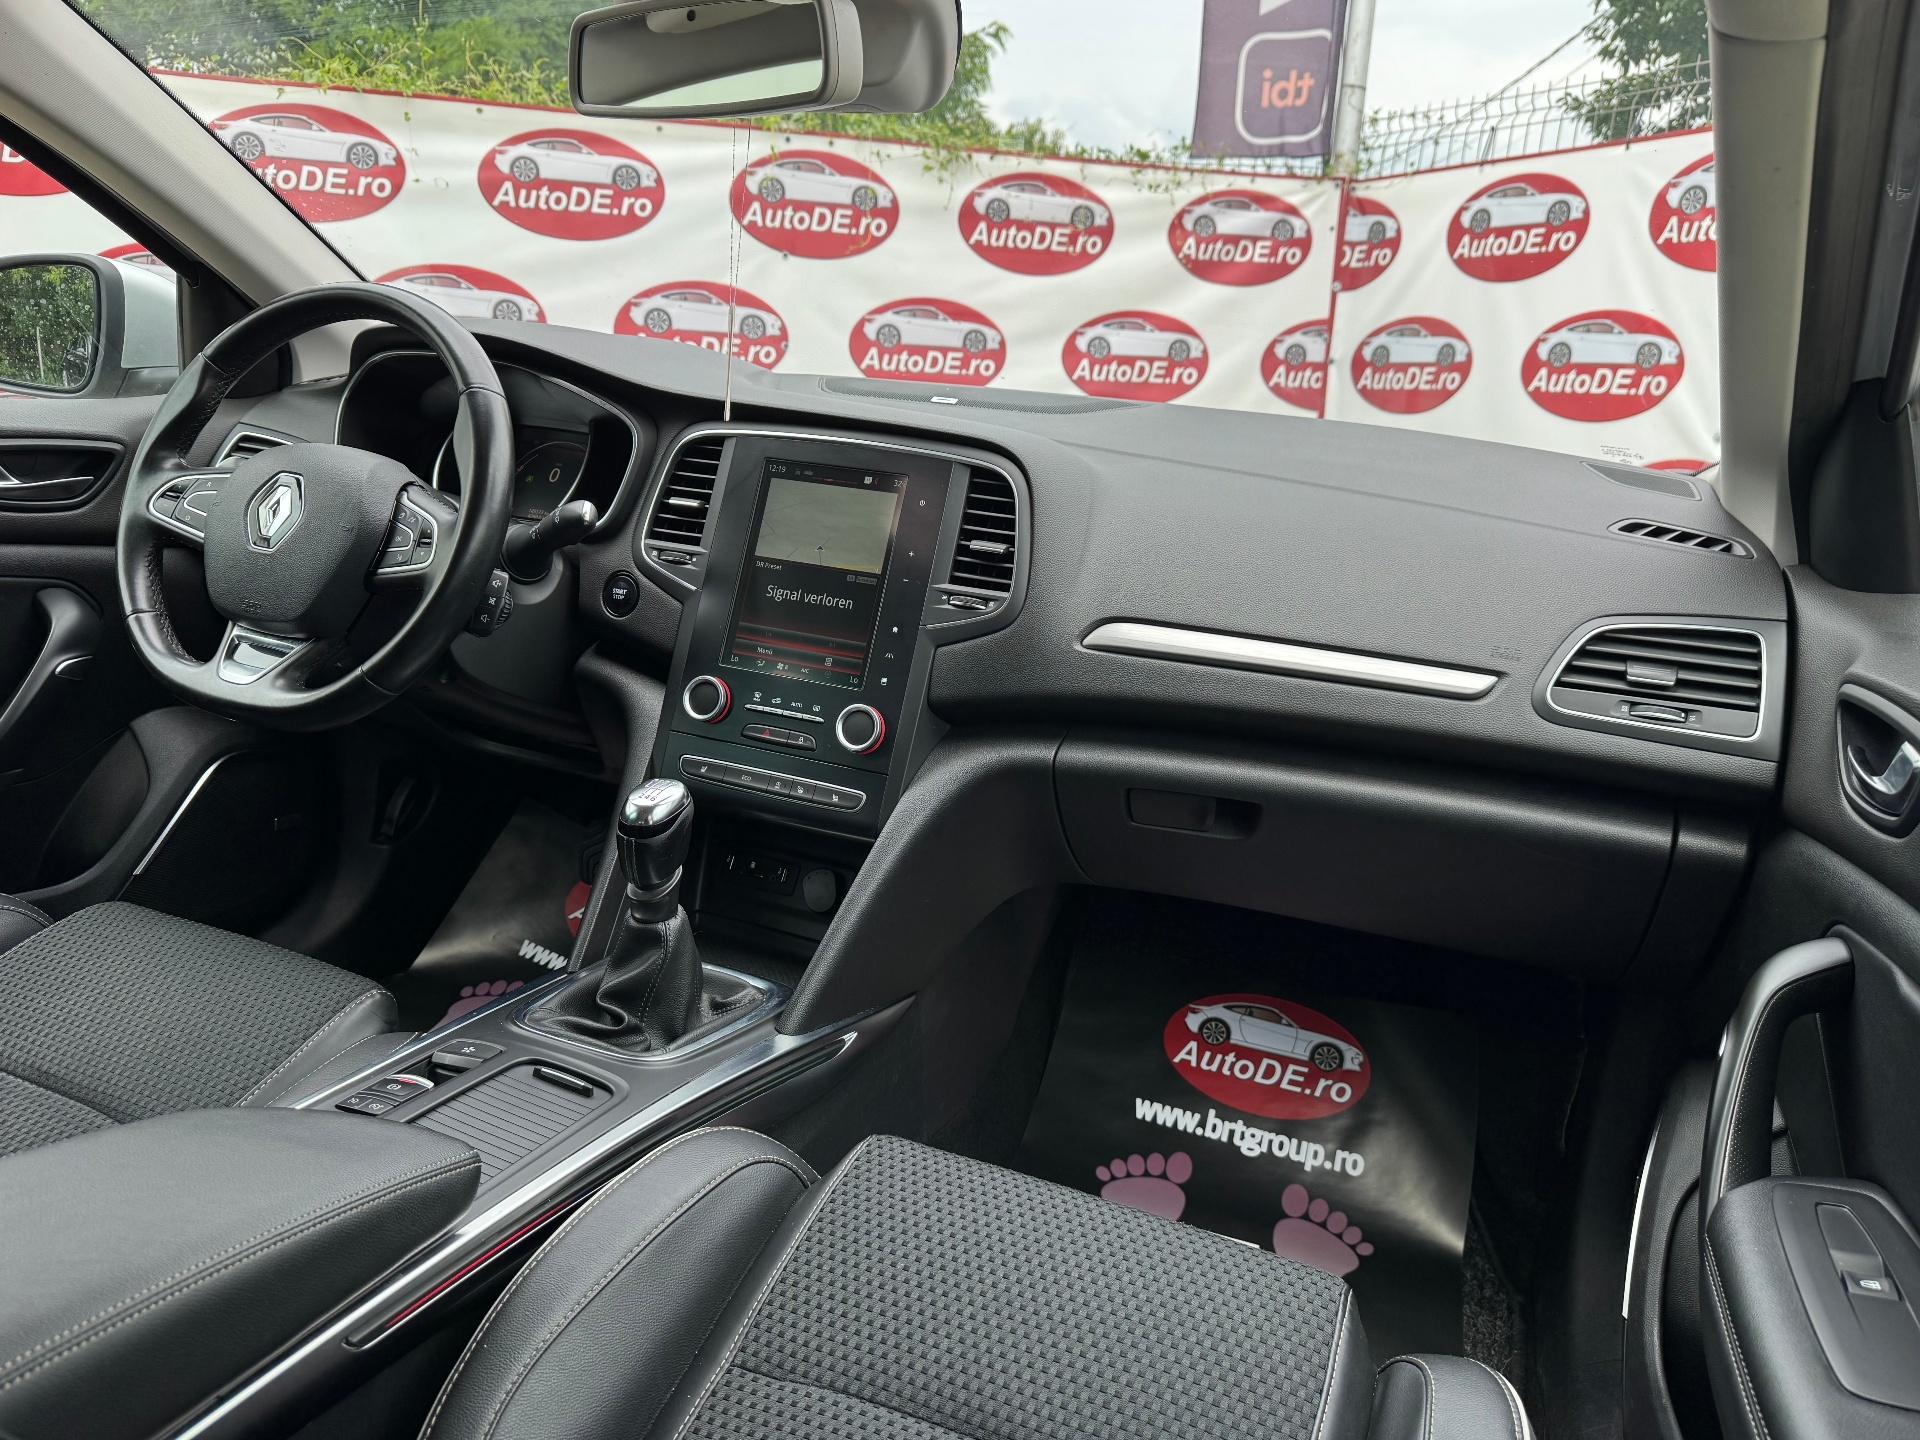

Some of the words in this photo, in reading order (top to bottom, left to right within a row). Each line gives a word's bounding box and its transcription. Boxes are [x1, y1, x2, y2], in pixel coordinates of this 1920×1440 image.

[492, 181, 653, 219] AutoDE.ro
[742, 201, 888, 238] AutoDE.ro
[968, 223, 1102, 255] AutoDE.ro
[1180, 236, 1302, 265] AutoDE.ro
[1453, 227, 1576, 261] AutoDE.ro
[860, 346, 996, 377] AutoDE.ro
[1072, 360, 1199, 385] AutoDE.ro
[1268, 364, 1323, 389] Auto
[1357, 366, 1461, 391] AutoDE.ro
[1527, 367, 1668, 397] AutoDE.ro
[549, 467, 560, 483] 0
[769, 464, 786, 473] 12:19
[612, 587, 628, 595] START
[766, 584, 802, 602] Signal
[804, 592, 853, 610] verloren
[1173, 1040, 1352, 1103] AutoDE.ro
[1135, 1097, 1365, 1177] www.brtgroup.ro
